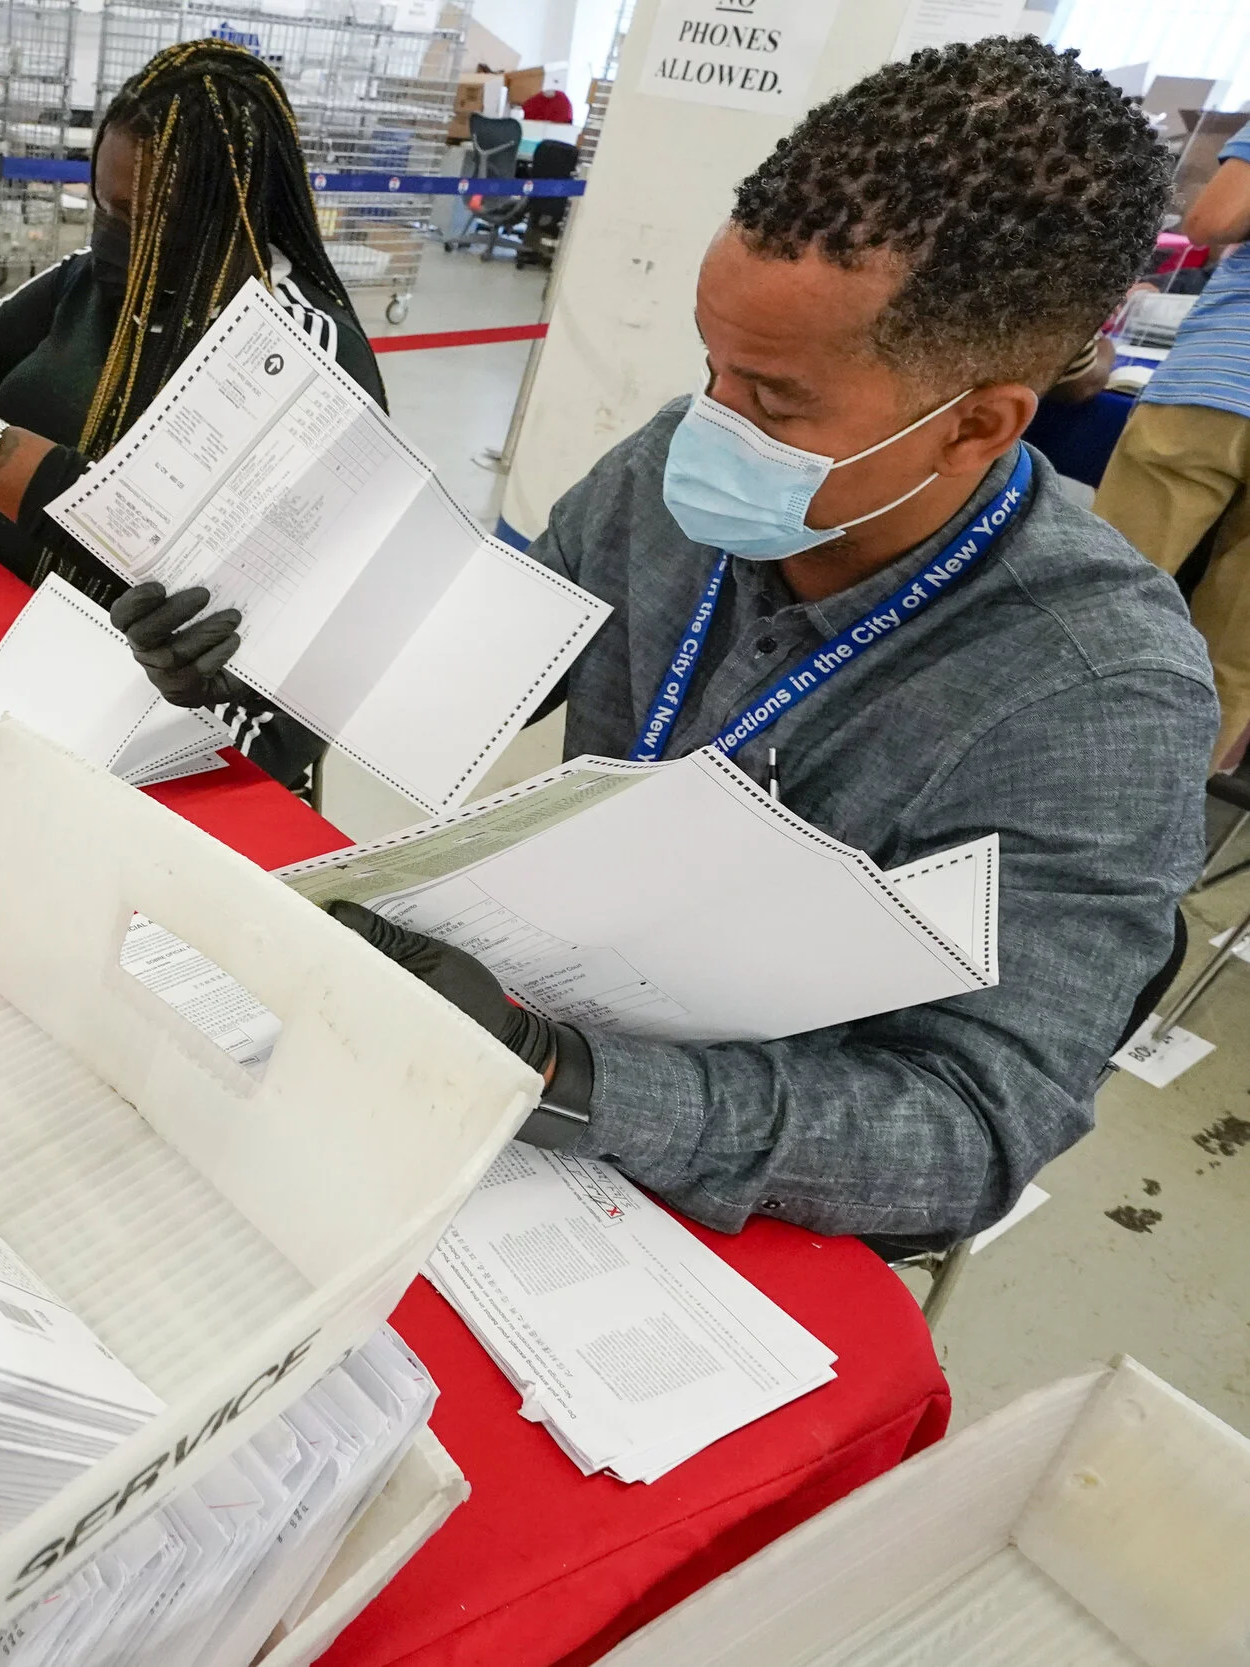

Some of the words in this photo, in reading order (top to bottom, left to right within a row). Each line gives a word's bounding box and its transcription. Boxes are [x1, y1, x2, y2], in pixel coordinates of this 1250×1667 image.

[678, 20, 782, 53] PHONES
[654, 57, 783, 95] ALLOWED.
[792, 669, 817, 693] in
[814, 643, 854, 675] the
[851, 608, 903, 646] City
[902, 582, 928, 611] of
[924, 539, 980, 588] New
[972, 487, 1022, 537] York
[691, 599, 712, 634] the
[671, 638, 698, 679] City
[661, 682, 681, 708] of
[643, 704, 676, 750] New
